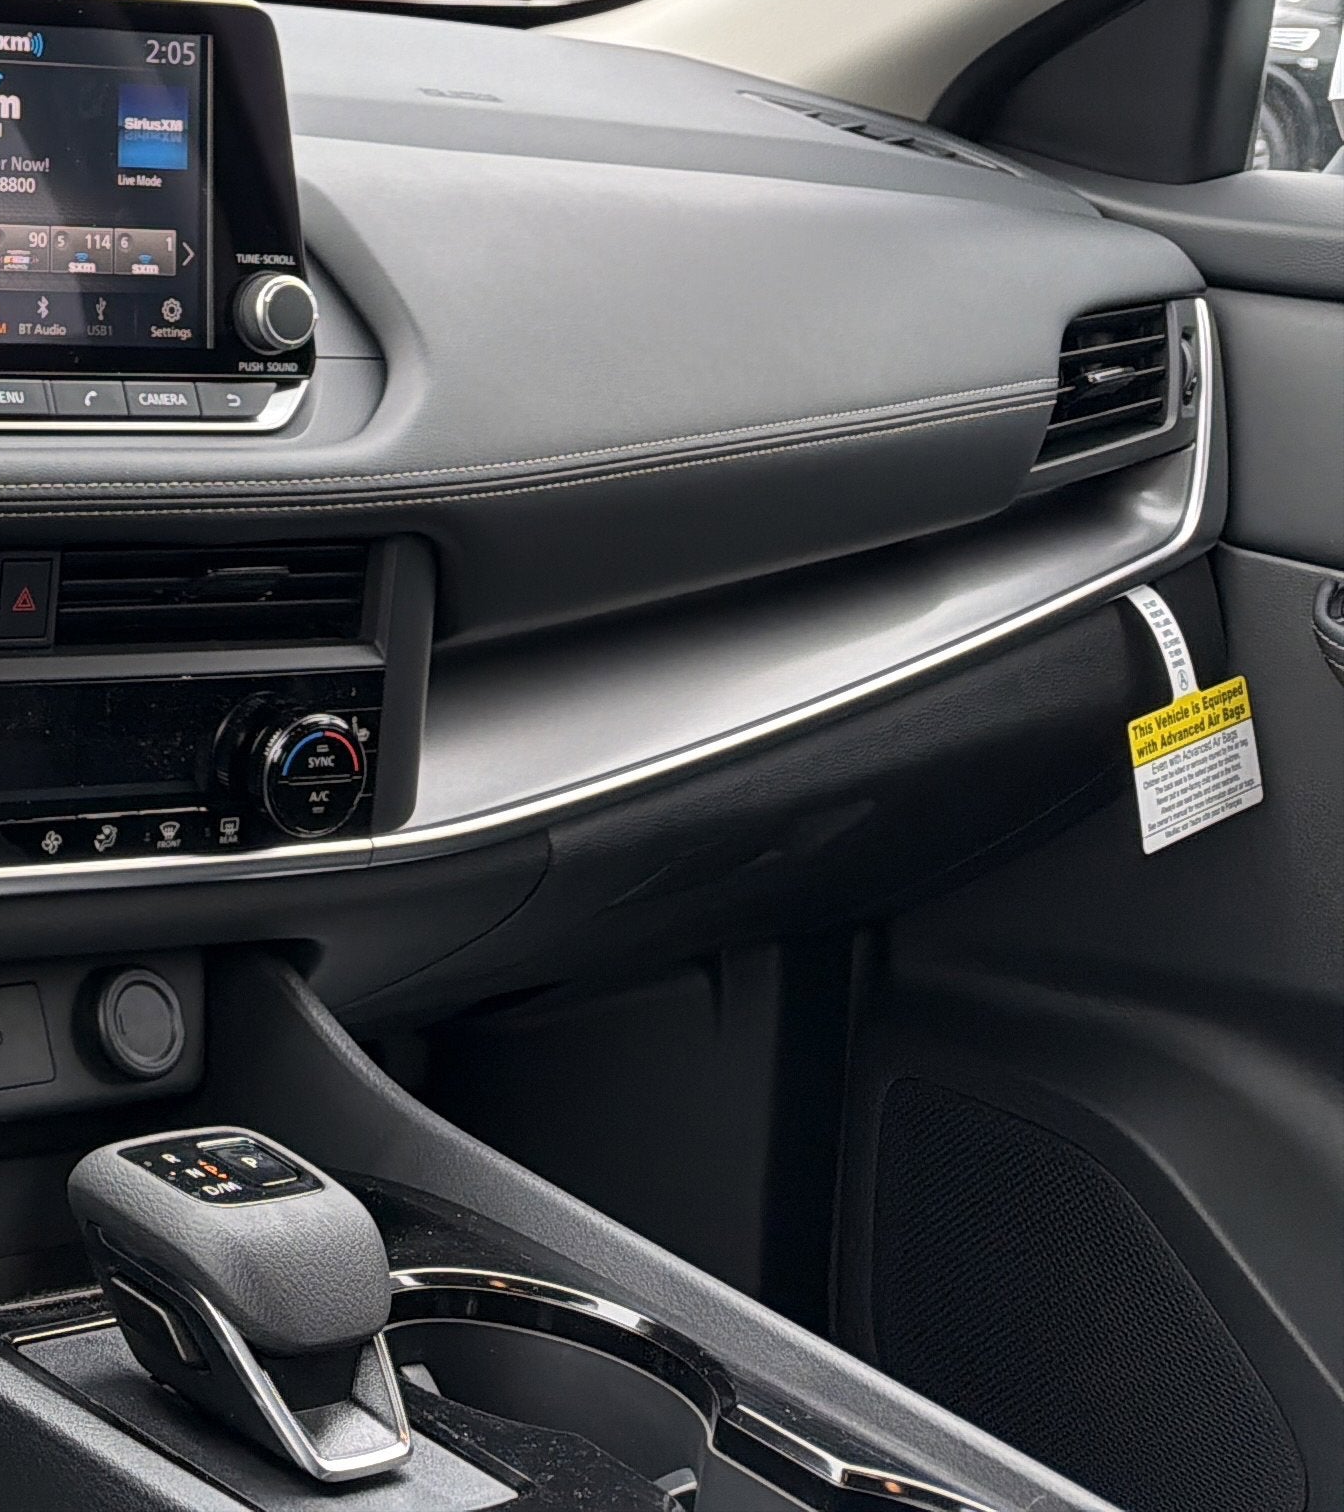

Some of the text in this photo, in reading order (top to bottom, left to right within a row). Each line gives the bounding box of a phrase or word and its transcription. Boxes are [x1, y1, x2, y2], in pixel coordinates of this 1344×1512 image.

[145, 40, 196, 65] 2:05
[124, 117, 184, 132] SiriusXM
[11, 156, 51, 173] Now!
[117, 174, 162, 188] Live Mode
[28, 231, 48, 248] 90
[57, 235, 65, 248] 5
[84, 233, 112, 250] 114
[120, 236, 129, 249] 6
[165, 237, 173, 252] 1
[18, 323, 67, 336] BT Audio
[86, 324, 113, 337] USB1
[150, 325, 192, 340] Settings
[238, 361, 298, 373] PUSH SOUND
[138, 392, 188, 407] CAMERA
[1131, 681, 1244, 741] This Vehicle is Equipped
[1136, 703, 1246, 759] with Advanced Air Bags
[307, 755, 335, 768] SYNC
[308, 790, 330, 803] A/C
[156, 839, 181, 849] FRONT
